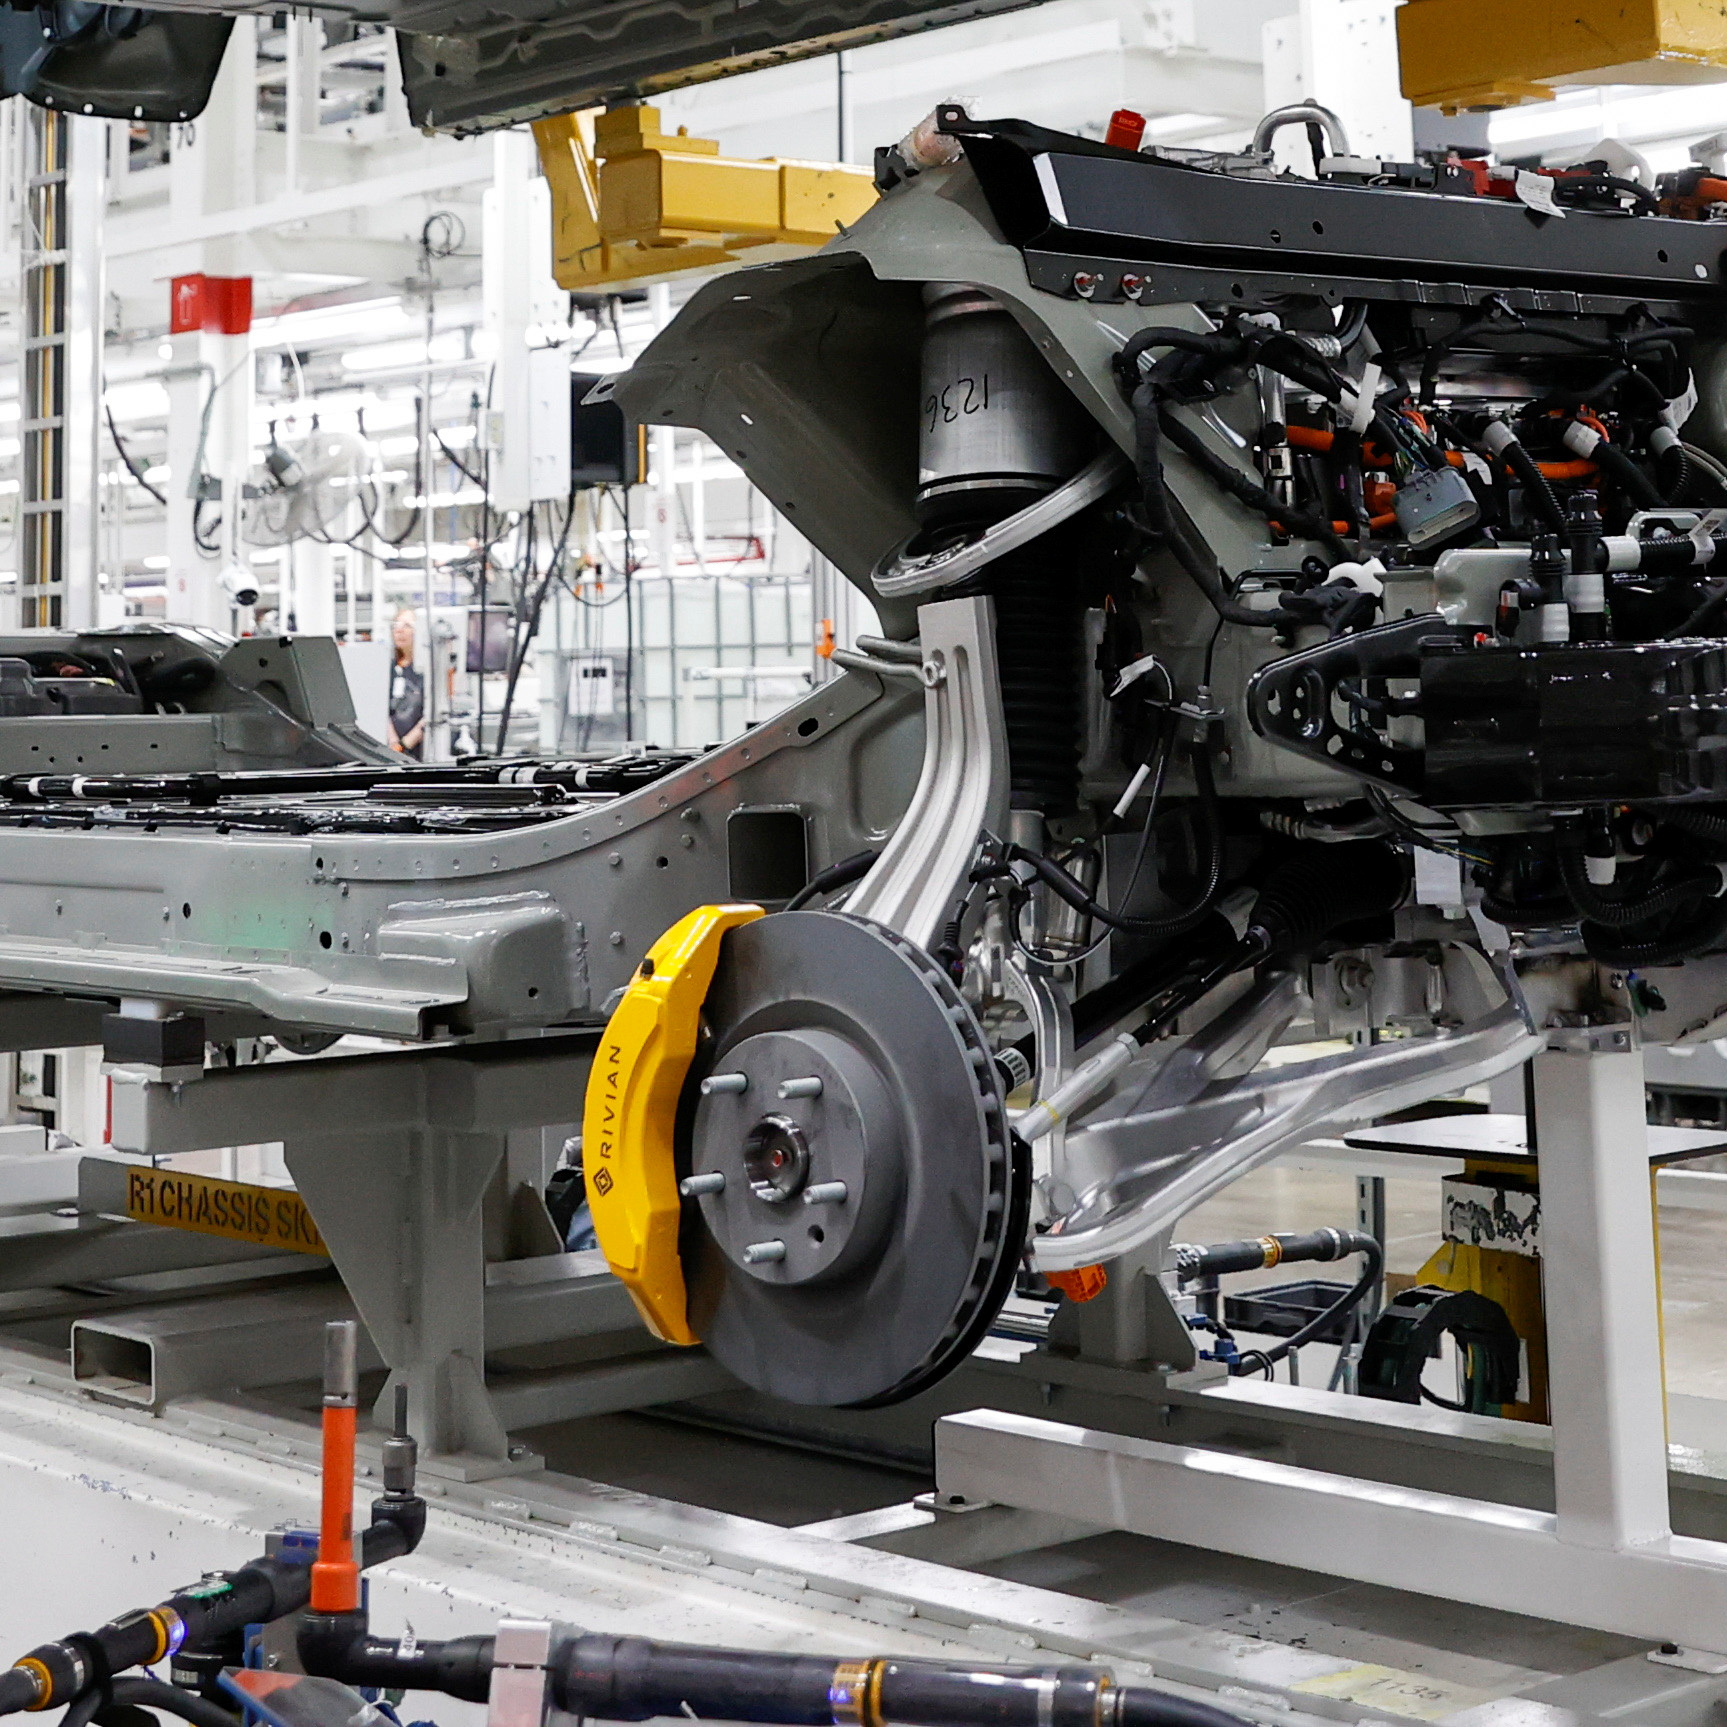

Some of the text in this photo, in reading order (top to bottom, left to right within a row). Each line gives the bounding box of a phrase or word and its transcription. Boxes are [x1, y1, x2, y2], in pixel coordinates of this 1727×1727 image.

[600, 1045, 621, 1159] RIVIAN
[159, 1179, 270, 1235] CHASSIS
[276, 1199, 319, 1245] SK
